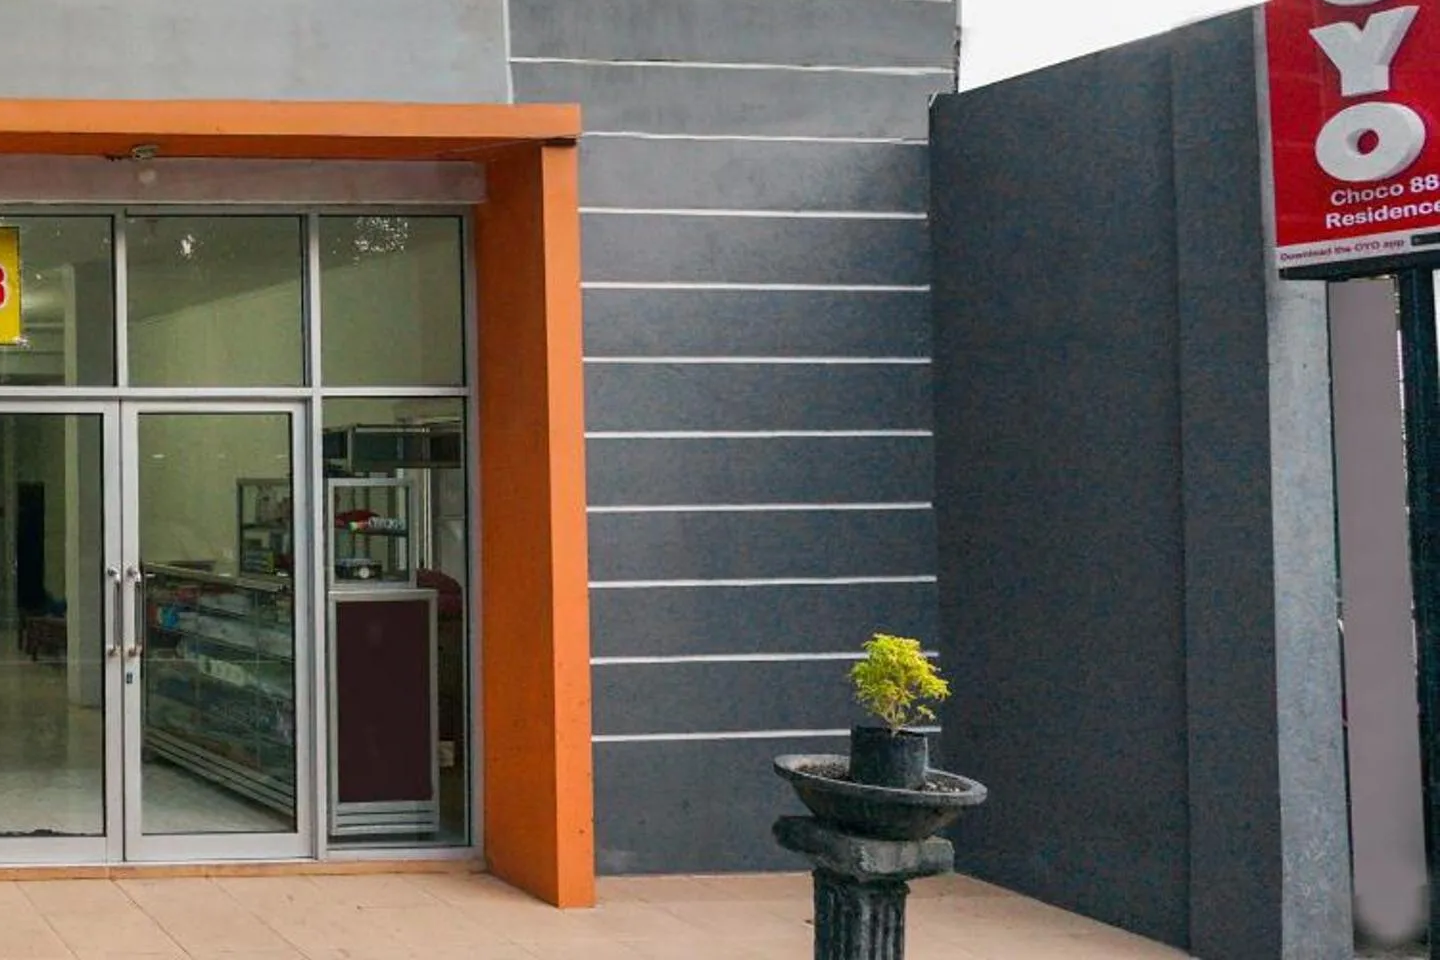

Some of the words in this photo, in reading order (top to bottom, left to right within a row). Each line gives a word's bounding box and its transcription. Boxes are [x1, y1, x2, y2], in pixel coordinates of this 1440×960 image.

[1331, 184, 1404, 206] Choco
[1410, 174, 1439, 193] 88
[1325, 200, 1440, 229] Residence
